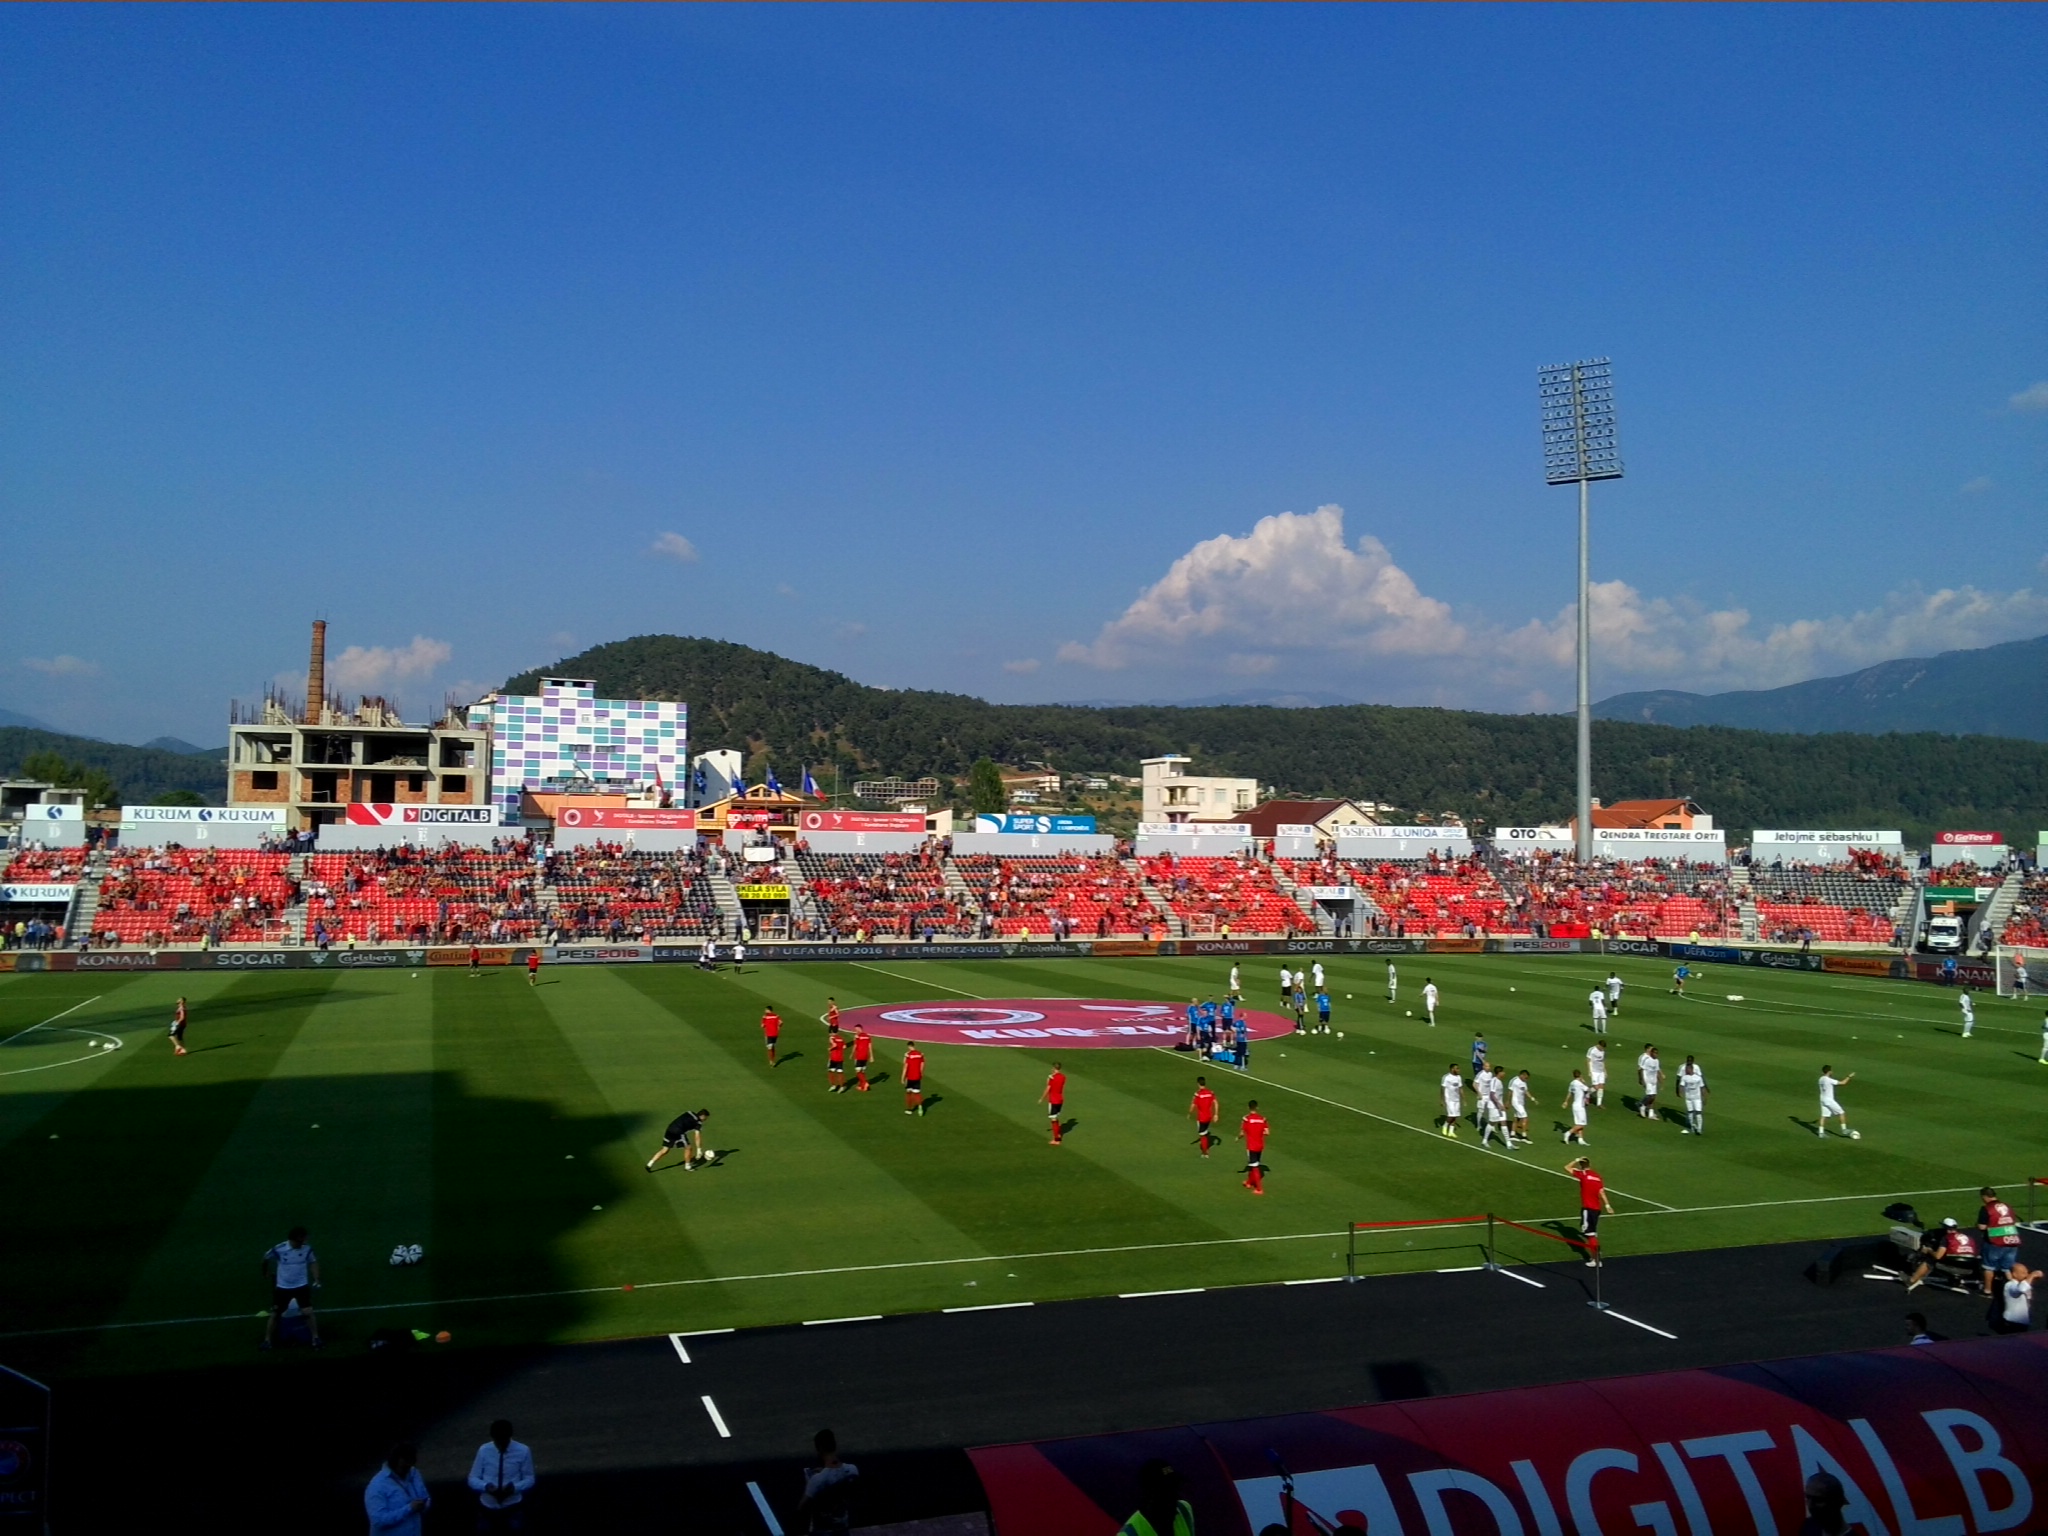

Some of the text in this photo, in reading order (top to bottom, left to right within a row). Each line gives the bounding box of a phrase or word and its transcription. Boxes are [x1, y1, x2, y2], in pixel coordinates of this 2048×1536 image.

[421, 810, 490, 822] DIGITALB
[1404, 828, 1438, 837] UNIQA
[1644, 831, 1691, 840] TREGTARE
[1694, 832, 1718, 841] ORTI
[20, 888, 70, 897] KURUM
[905, 945, 1000, 954] LE RENDEZ-VOUS
[1196, 942, 1249, 951] KONAMI
[1288, 941, 1333, 951] SOCAR
[1513, 941, 1571, 949] PES2016
[1608, 941, 1659, 953] SOCAR
[556, 949, 640, 960] PES2016
[1684, 946, 1726, 958] UEFA.com
[77, 955, 156, 966] KONAMI
[217, 954, 286, 965] SOCAR
[338, 952, 397, 965] Carlsberg
[1760, 952, 1801, 967] Carlsberg
